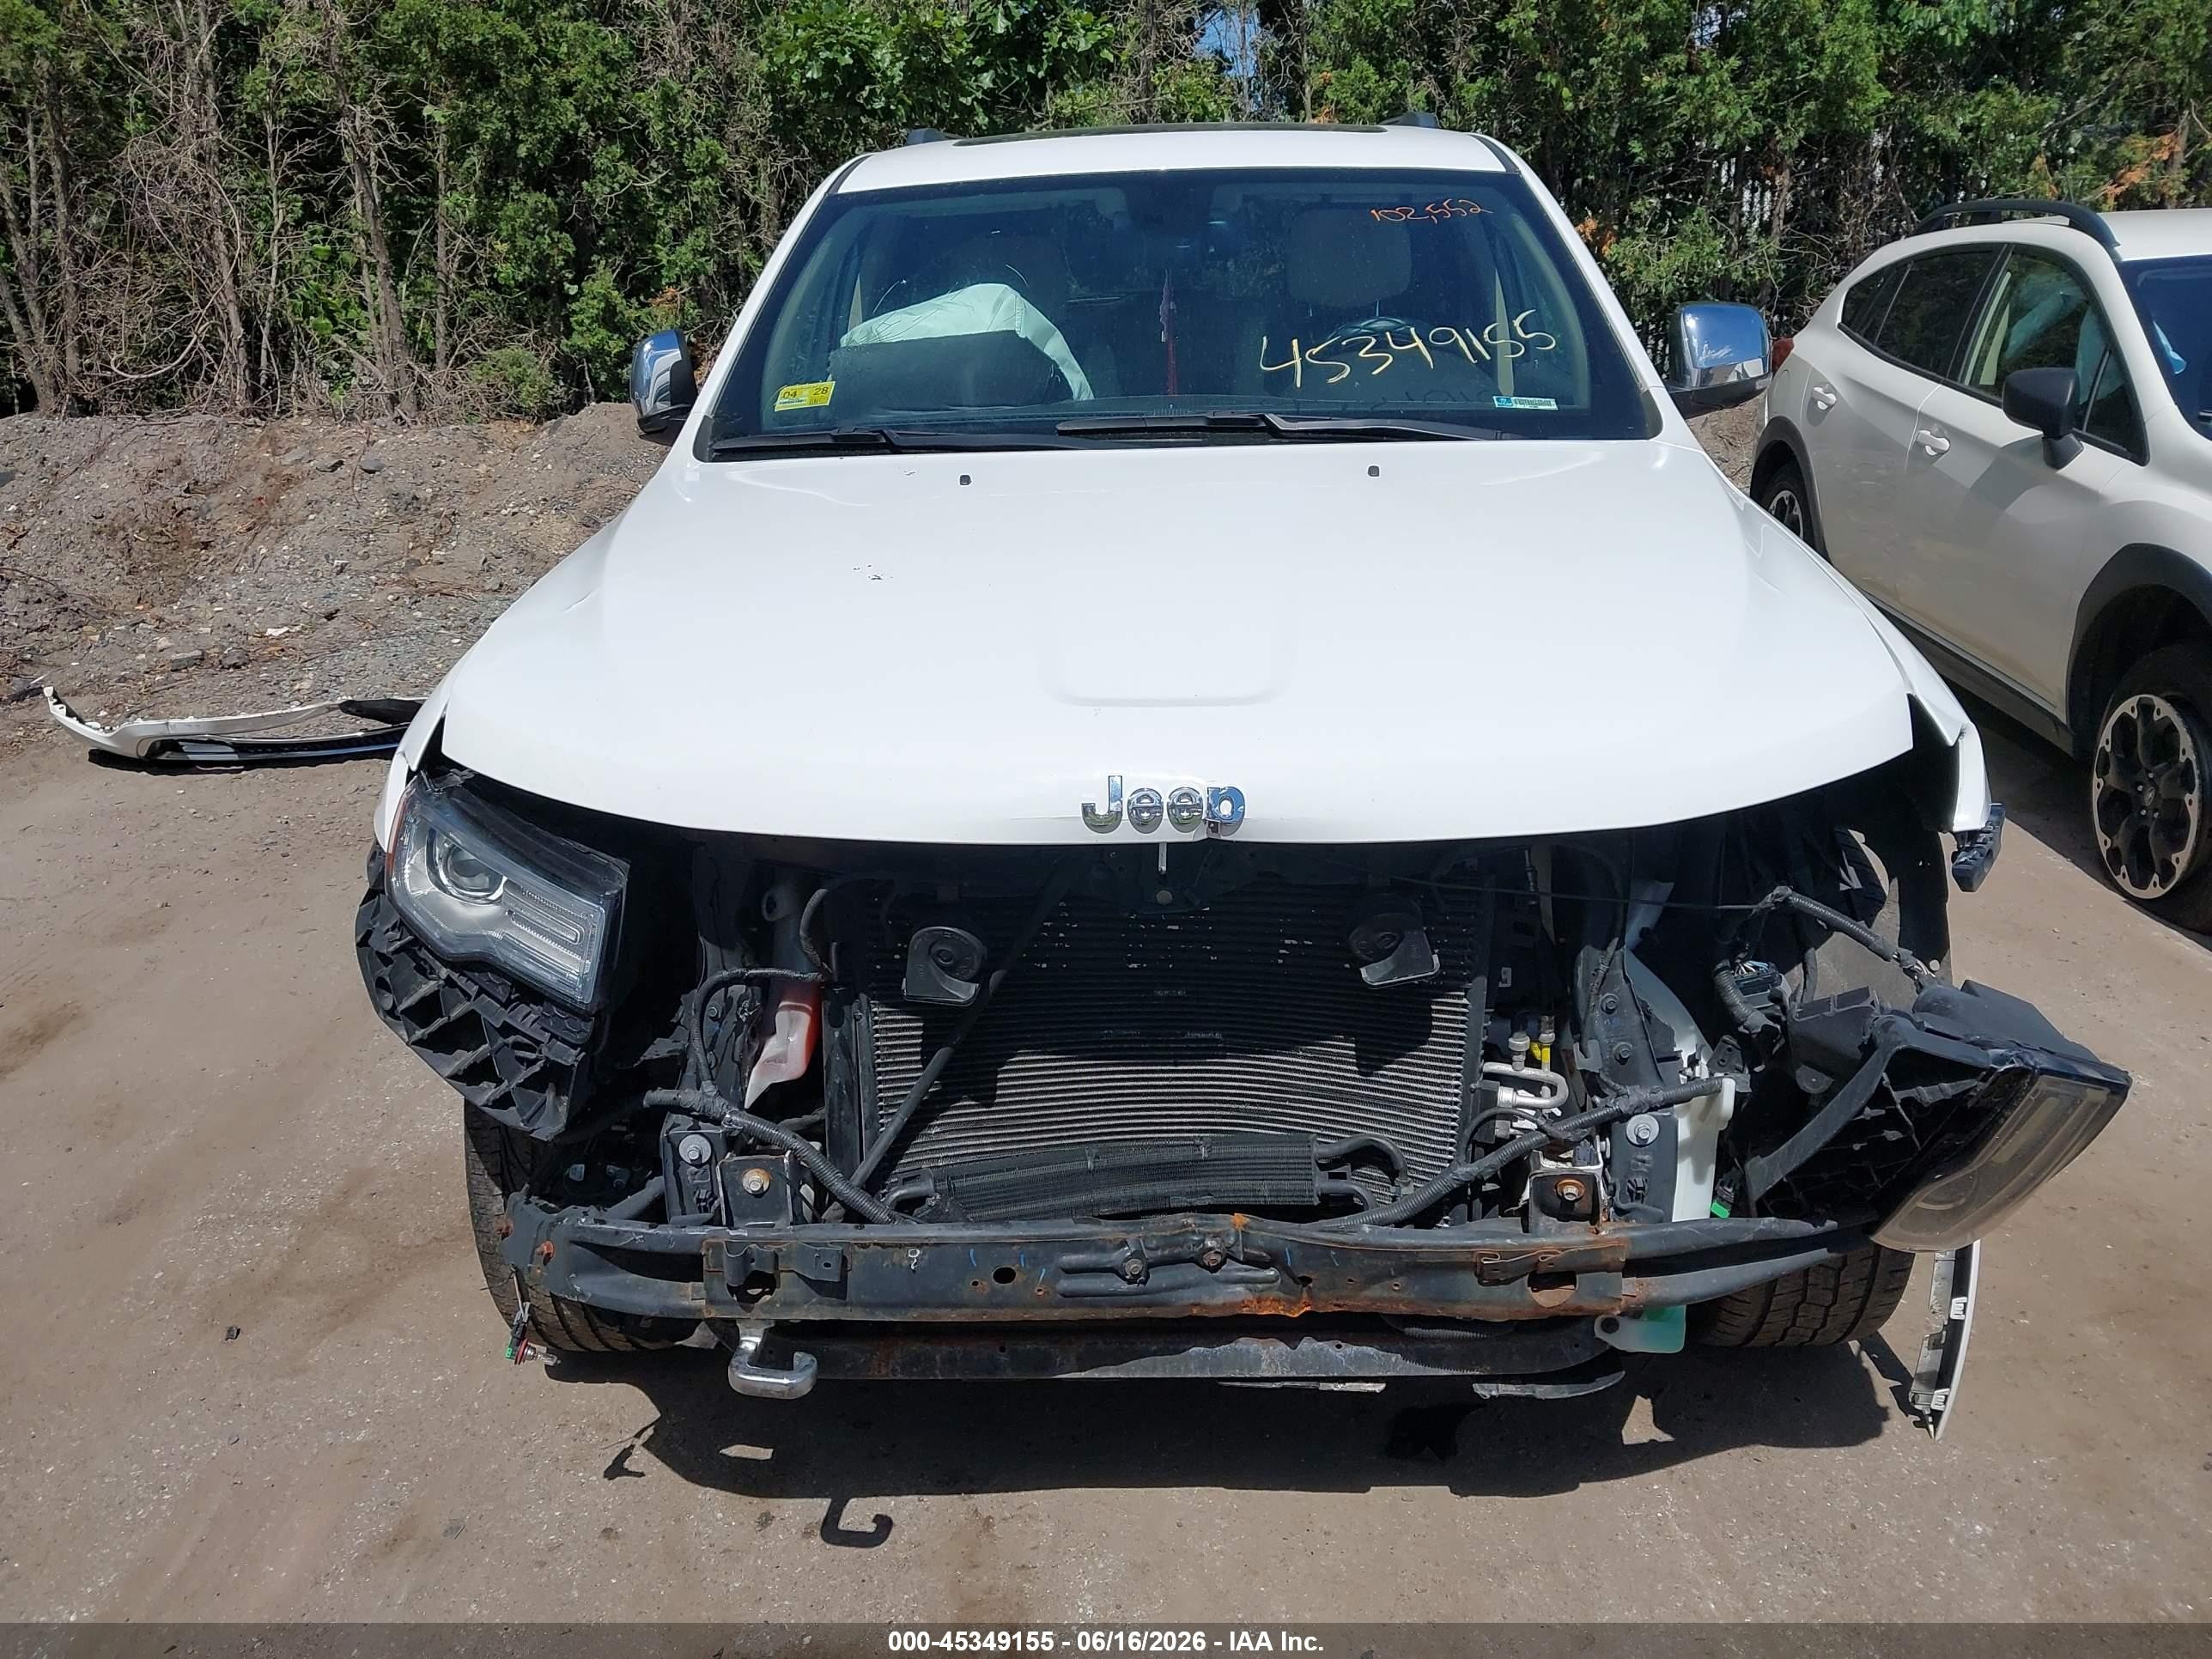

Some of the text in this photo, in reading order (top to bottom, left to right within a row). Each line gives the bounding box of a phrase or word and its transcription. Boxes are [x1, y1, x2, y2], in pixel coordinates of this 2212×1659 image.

[1370, 198, 1493, 224] 102,552
[1260, 309, 1556, 388] 45349155
[813, 386, 830, 396] 28
[1081, 775, 1246, 837] Jeep
